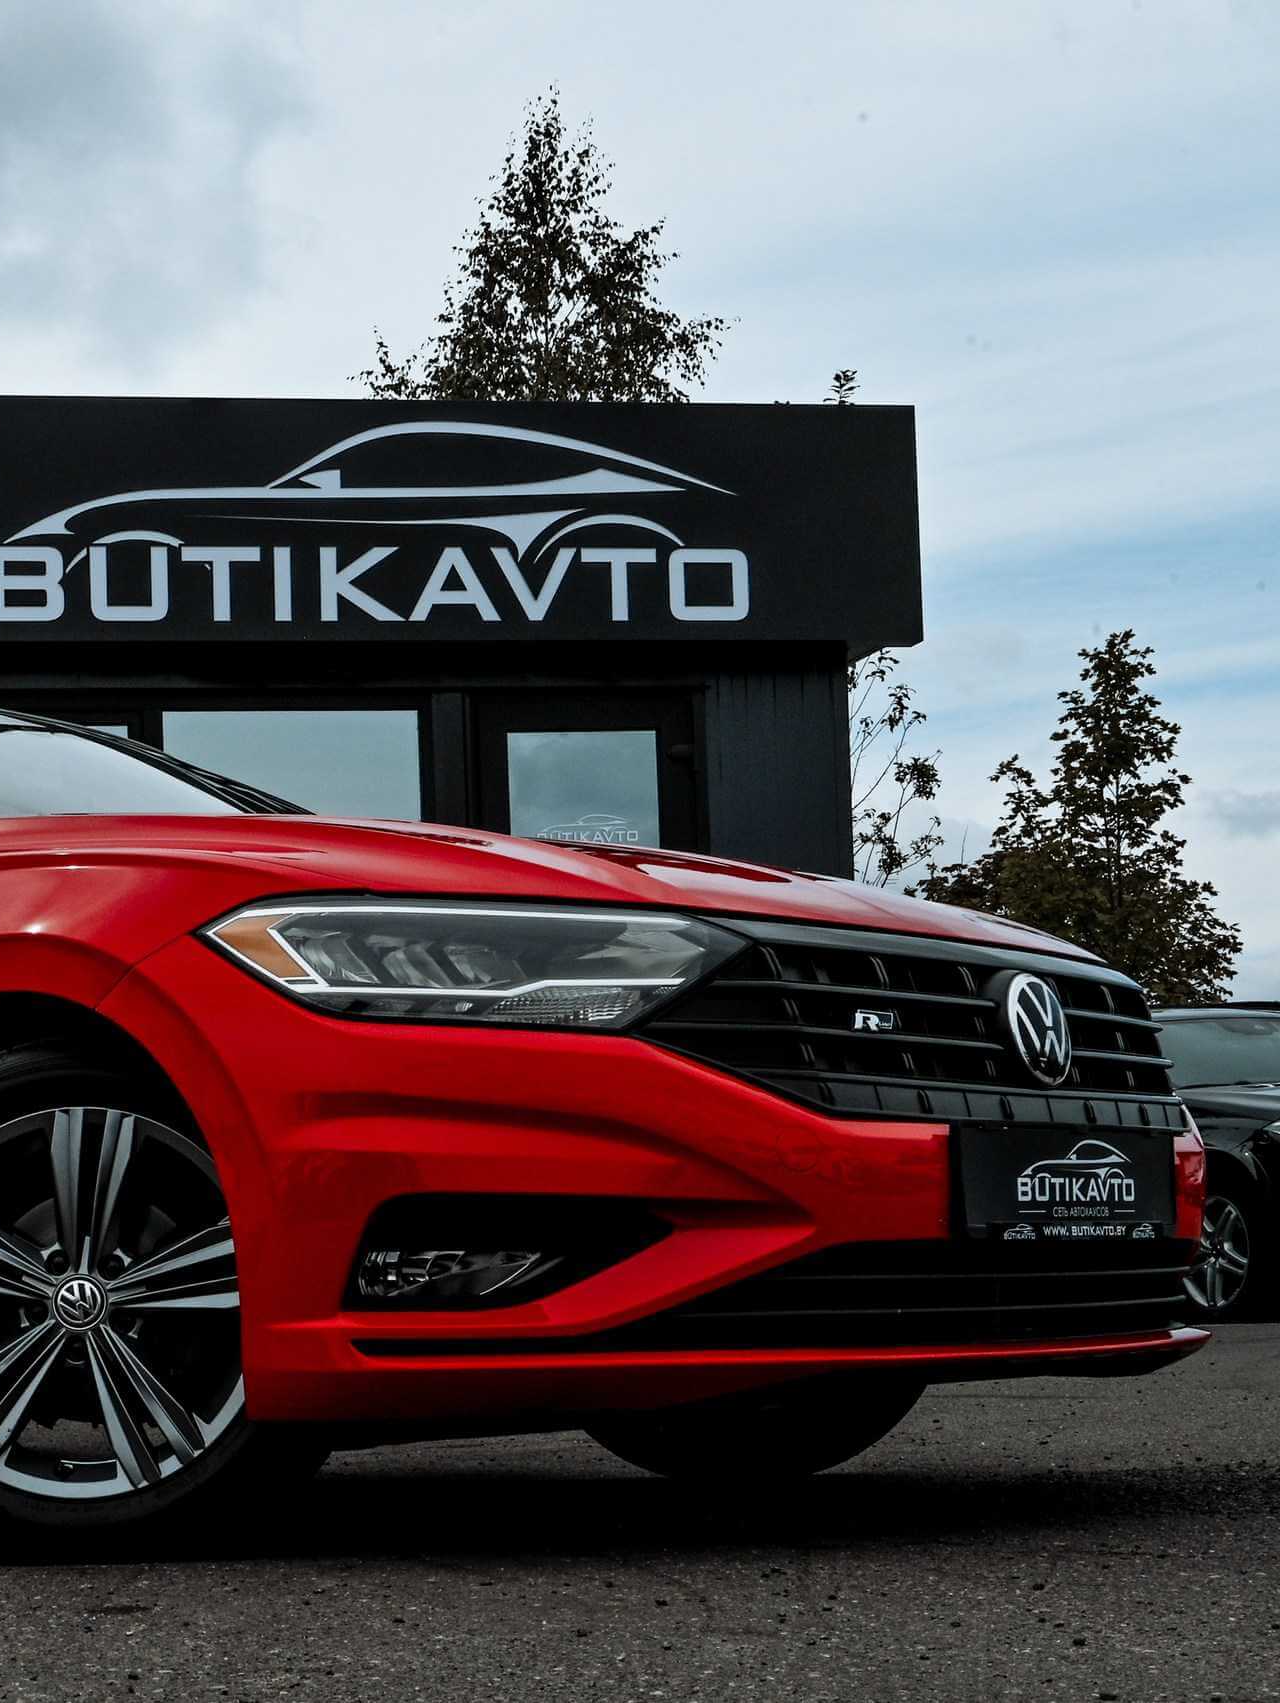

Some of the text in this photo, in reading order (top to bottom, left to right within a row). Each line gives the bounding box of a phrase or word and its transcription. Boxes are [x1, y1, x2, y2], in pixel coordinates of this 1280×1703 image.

[1017, 1177, 1135, 1202] BUTIKAVTO
[1052, 1206, 1069, 1217] СЕТЬ
[1043, 1226, 1127, 1237] WWW. BUTIKAVTO.BY
